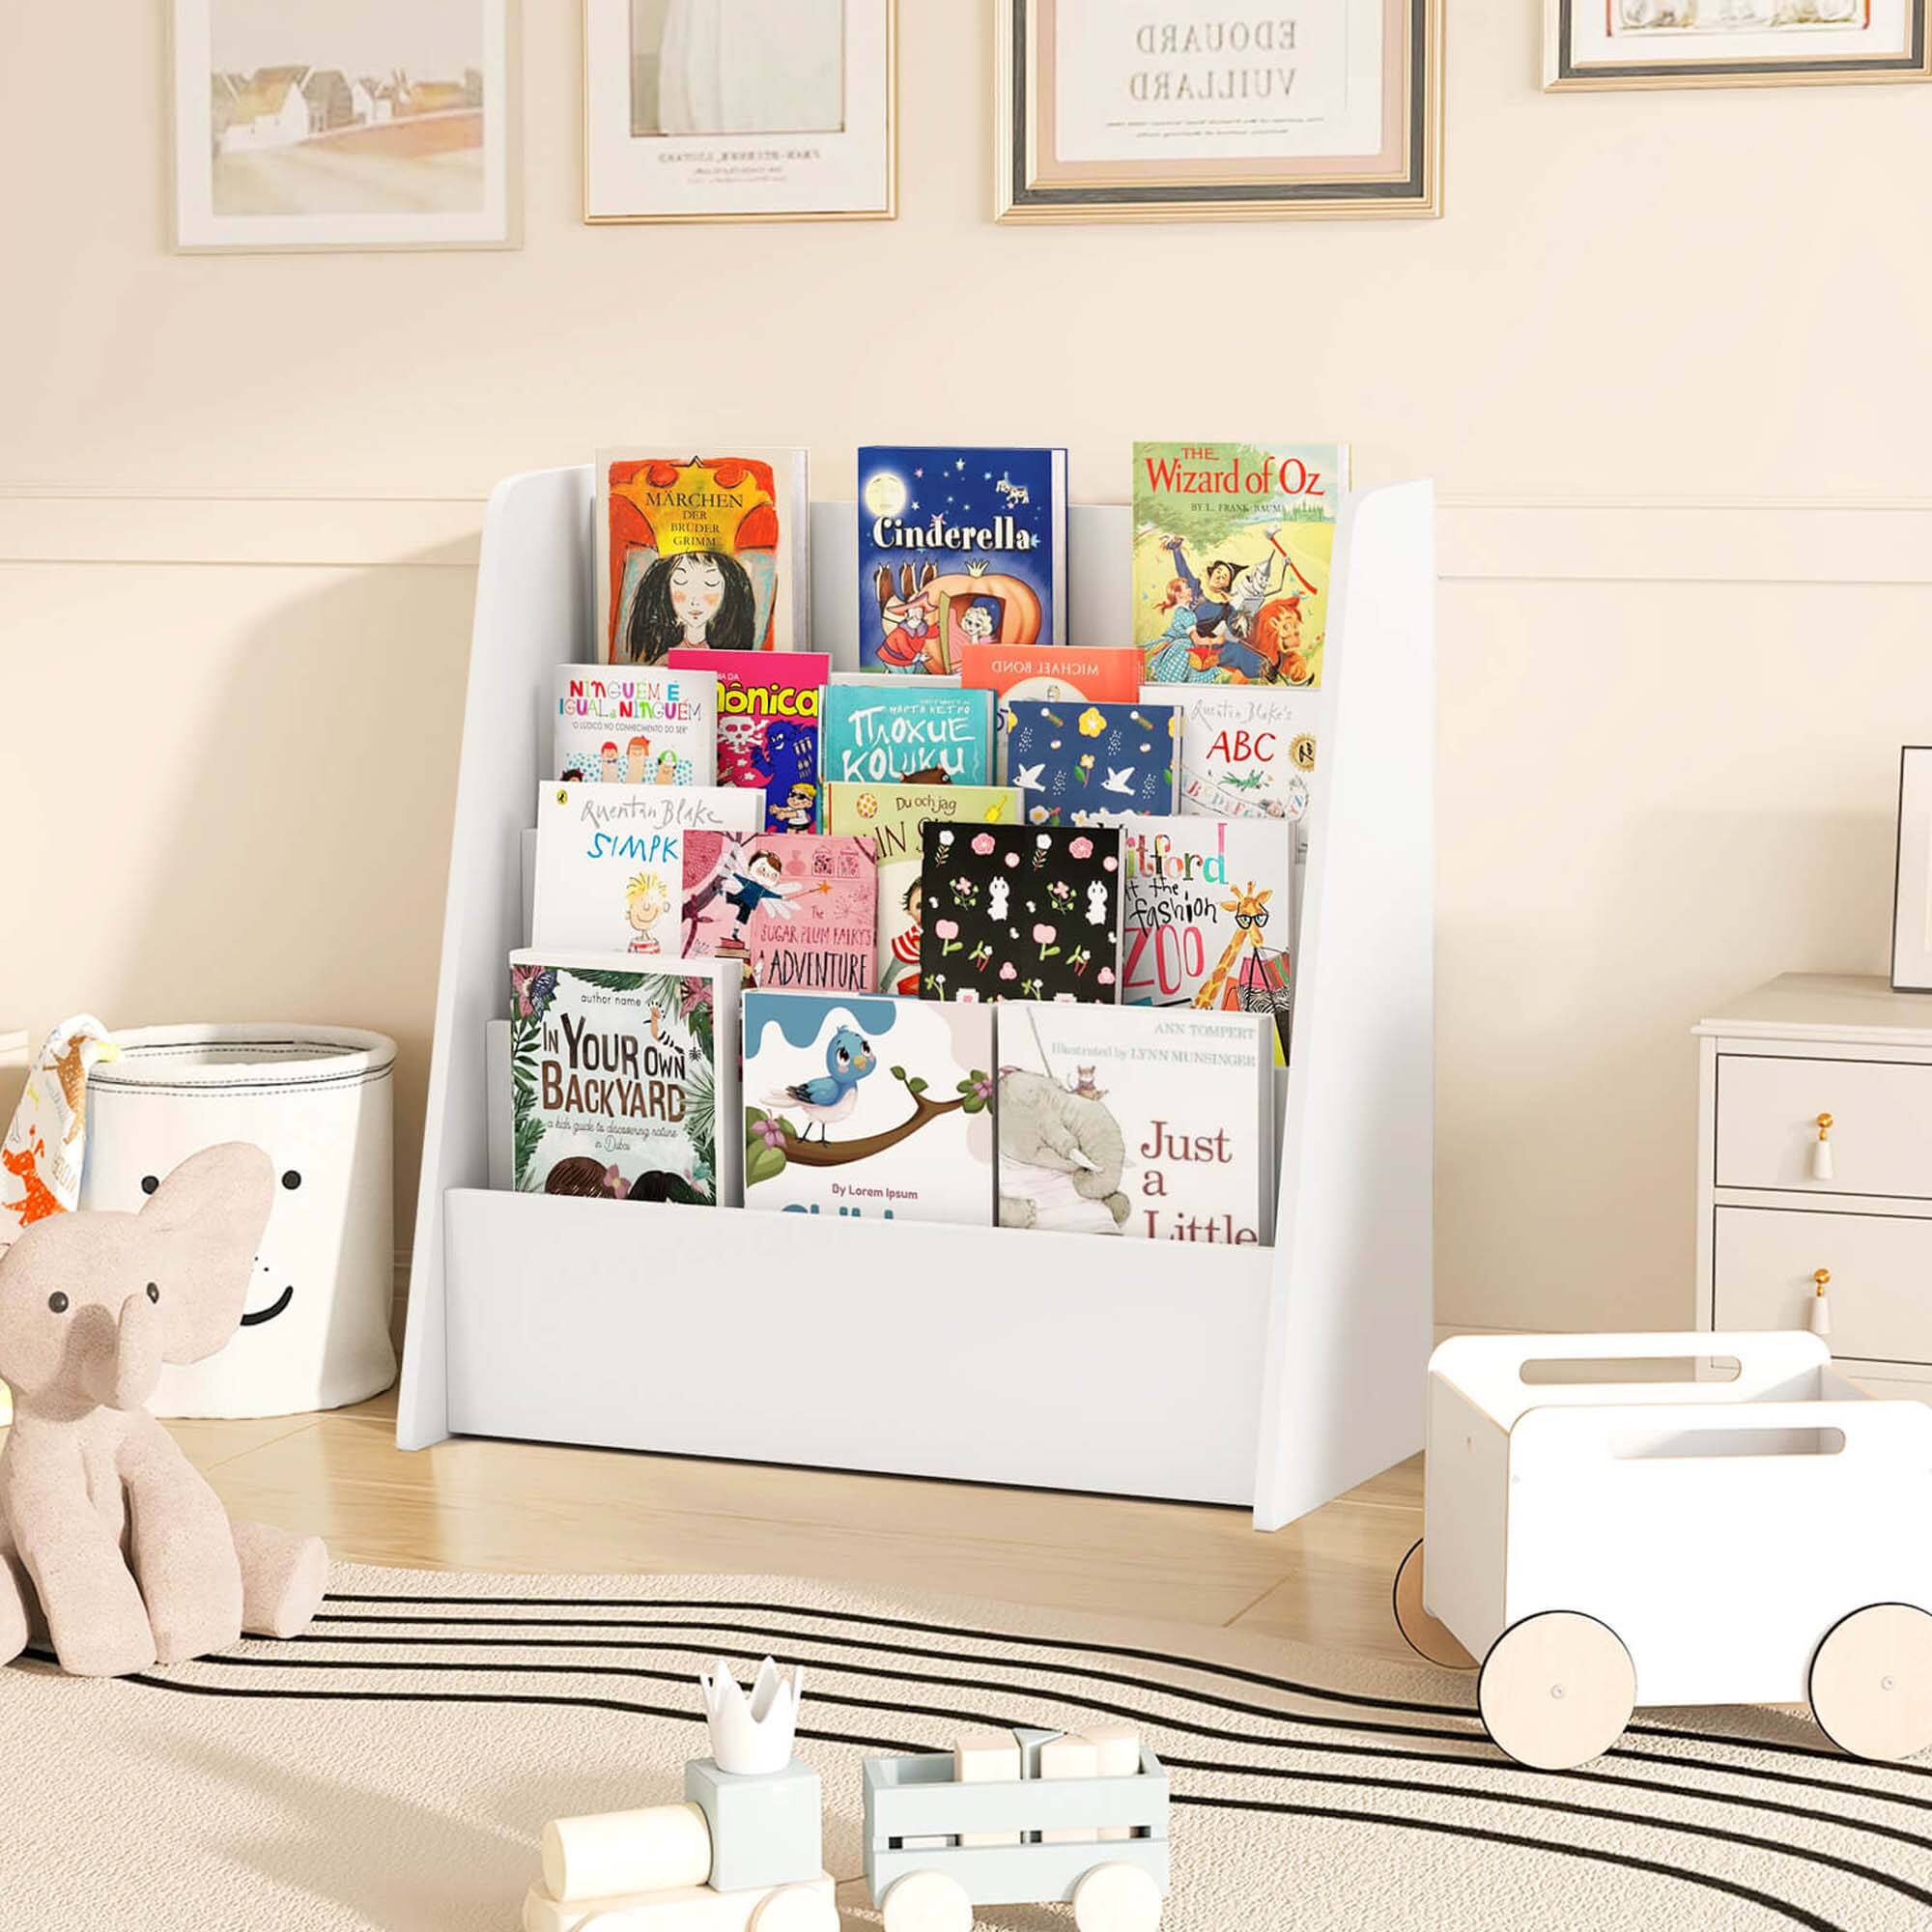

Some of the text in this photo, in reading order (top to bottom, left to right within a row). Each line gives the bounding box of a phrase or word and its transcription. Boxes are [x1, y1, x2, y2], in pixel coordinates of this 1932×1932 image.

[1180, 447, 1220, 461] THE
[1146, 456, 1324, 496] Wizard of Oz
[645, 491, 743, 508] MÄRCHEN
[682, 510, 707, 520] DER
[673, 536, 716, 547] GRIMM
[873, 515, 1031, 551] Cinderella
[559, 697, 609, 718] IGUAL
[1206, 729, 1276, 763] ABC
[654, 799, 724, 830] Blake
[896, 794, 957, 816] Du och jag
[1149, 877, 1179, 897] the
[1129, 891, 1217, 938] fashion
[760, 923, 797, 943] SUGAR
[801, 926, 829, 946] PLUM
[768, 949, 867, 989] ADVENTURE
[1123, 924, 1205, 996] ZOO
[581, 992, 641, 1007] author name
[1154, 1022, 1256, 1039] ANN TOMPERT
[543, 1012, 686, 1081] IN YOUR OWN
[1114, 1047, 1128, 1060] by
[1130, 1048, 1168, 1062] LYNN
[541, 1060, 687, 1123] BACKYARD
[1140, 1120, 1233, 1164] Just
[832, 1182, 918, 1201] By Lorem Ipsum
[1142, 1169, 1167, 1197] a
